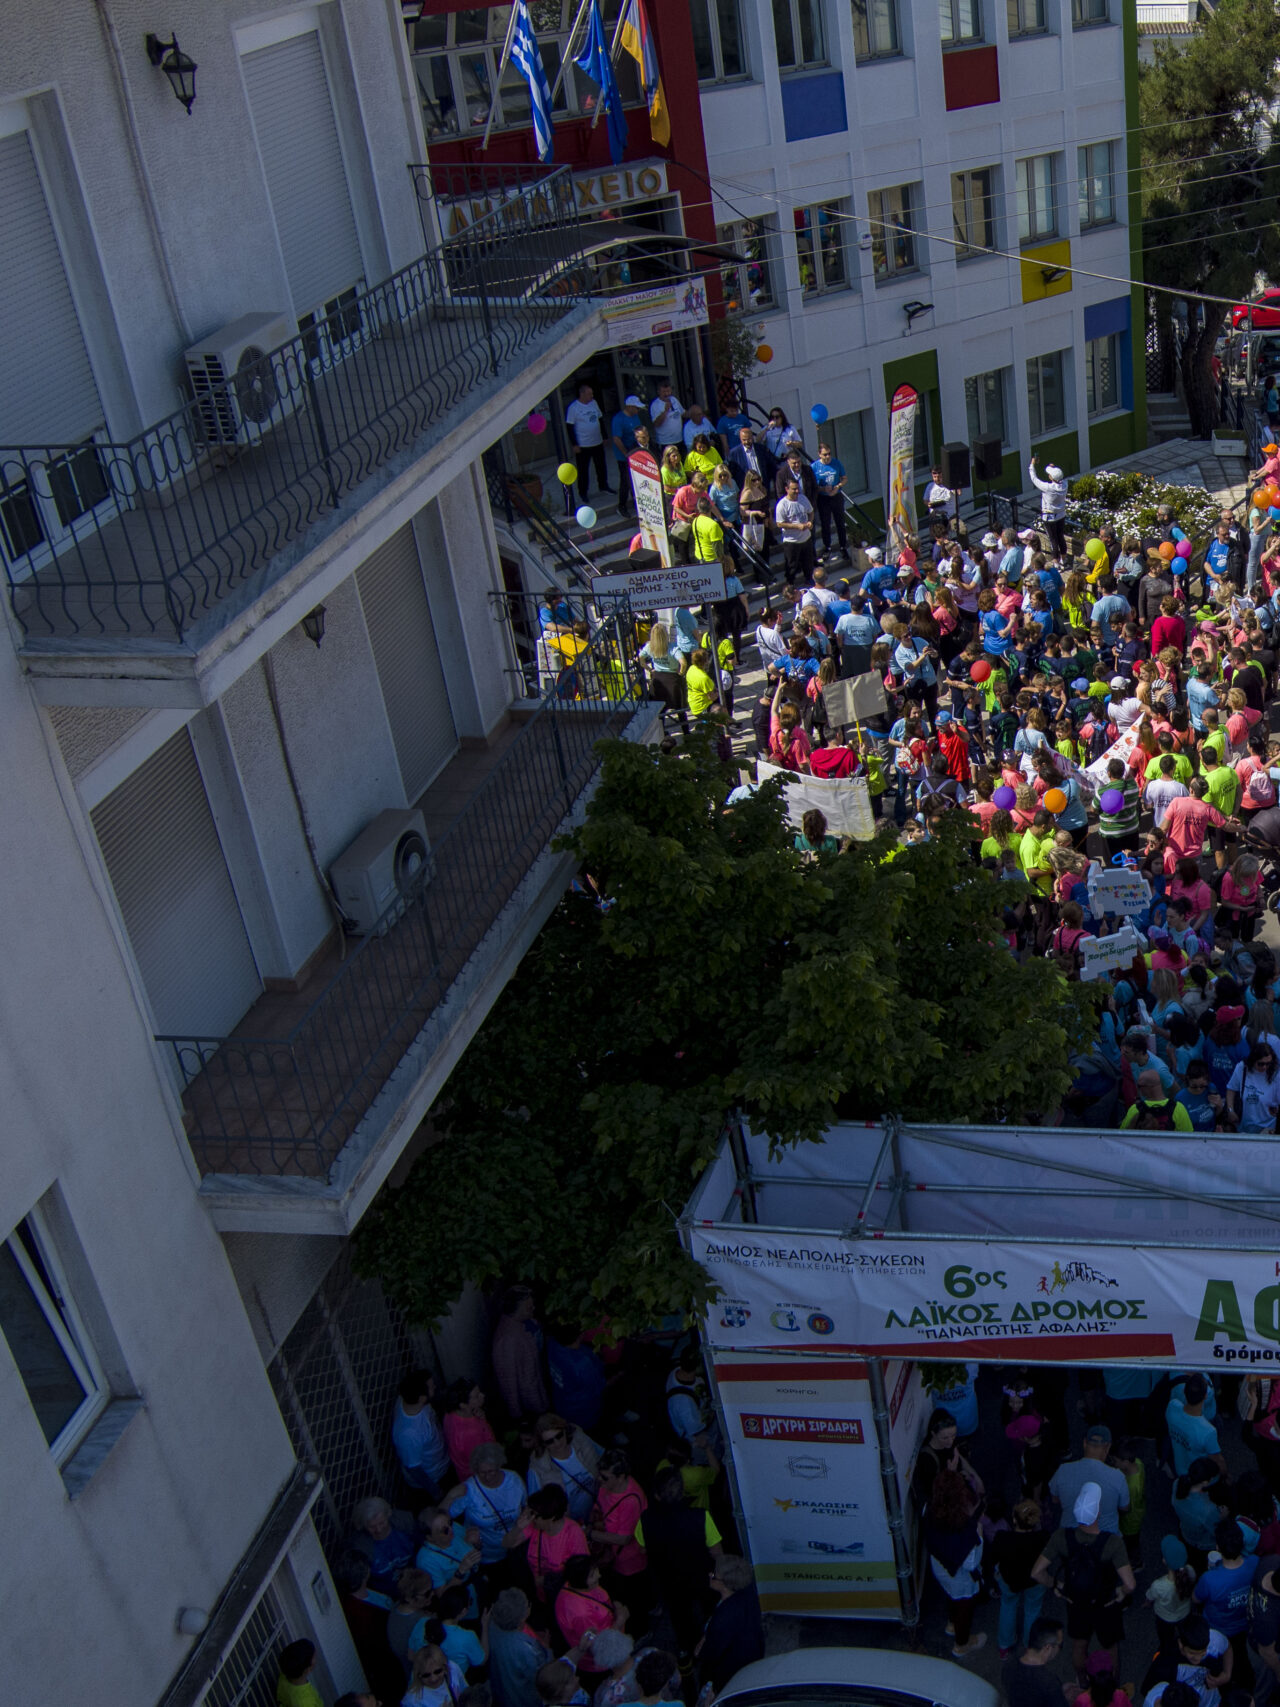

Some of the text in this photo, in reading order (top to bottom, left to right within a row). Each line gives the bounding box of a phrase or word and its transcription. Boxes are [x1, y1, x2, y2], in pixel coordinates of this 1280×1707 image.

[607, 584, 663, 596] ΝΕΑΠΟΛΗΣ
[671, 578, 712, 590] ΣΥΚΕΩΝ
[628, 570, 689, 585] ΔΗΜΑΡΧΕΙΟ
[705, 1243, 925, 1266] ΔΗΜΟΣ ΝΕΑΠΟΛΗΣ-ΣΥΚΕΩΝ
[943, 1265, 1007, 1299] 6ος
[884, 1300, 1148, 1328] ΛΑΪΚΟΣ ΔΡΟΜΟΣ
[763, 1418, 858, 1437] ΑΡΓΥΡΗ ΣΙΡΔΑΡΗ
[794, 1500, 859, 1509] ΣΚΑΛΩΣΙΕΣ
